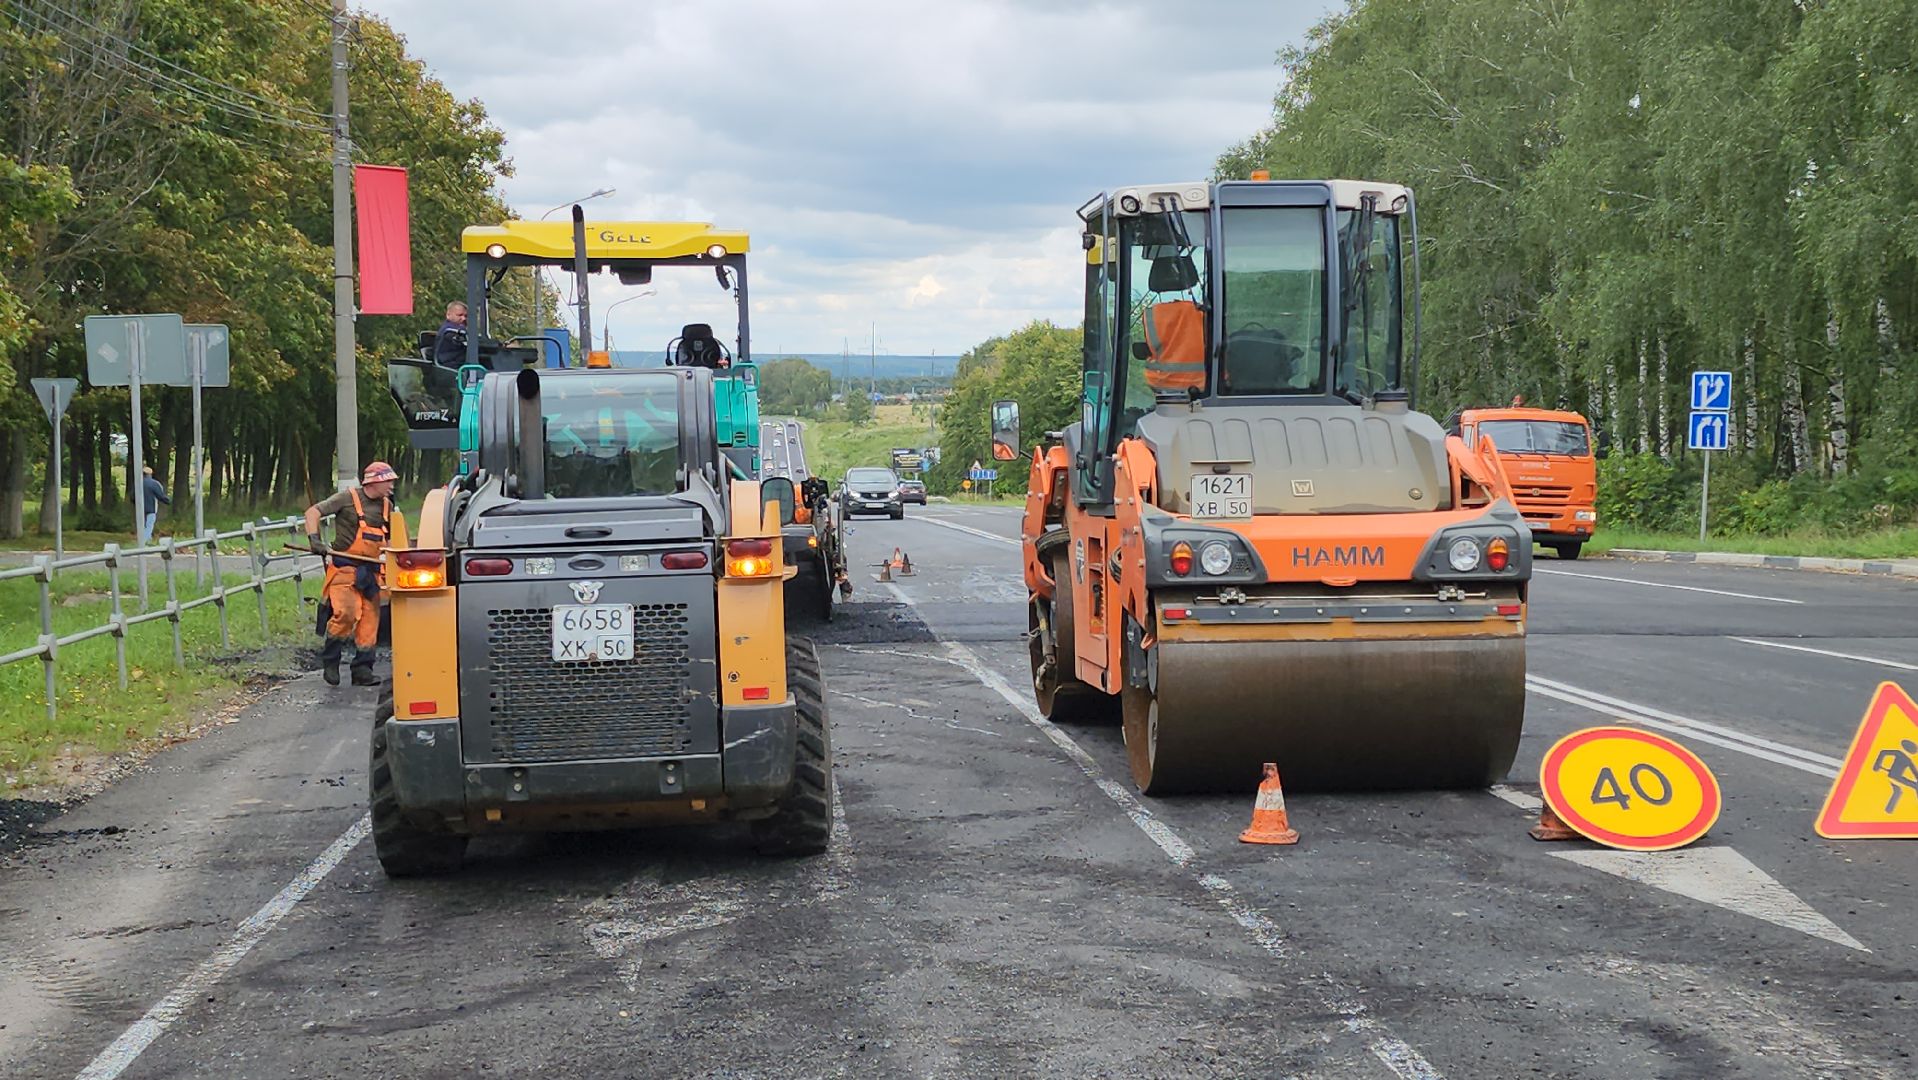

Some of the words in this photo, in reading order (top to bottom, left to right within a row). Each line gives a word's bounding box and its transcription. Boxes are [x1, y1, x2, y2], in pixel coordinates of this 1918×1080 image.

[1200, 476, 1245, 495] 1621
[1196, 502, 1218, 516] ХВ
[1229, 501, 1248, 515] 50
[1292, 546, 1386, 567] HAMM
[563, 609, 622, 631] 6658
[560, 640, 587, 658] ХК
[603, 639, 626, 657] 50
[1590, 763, 1673, 811] 40
